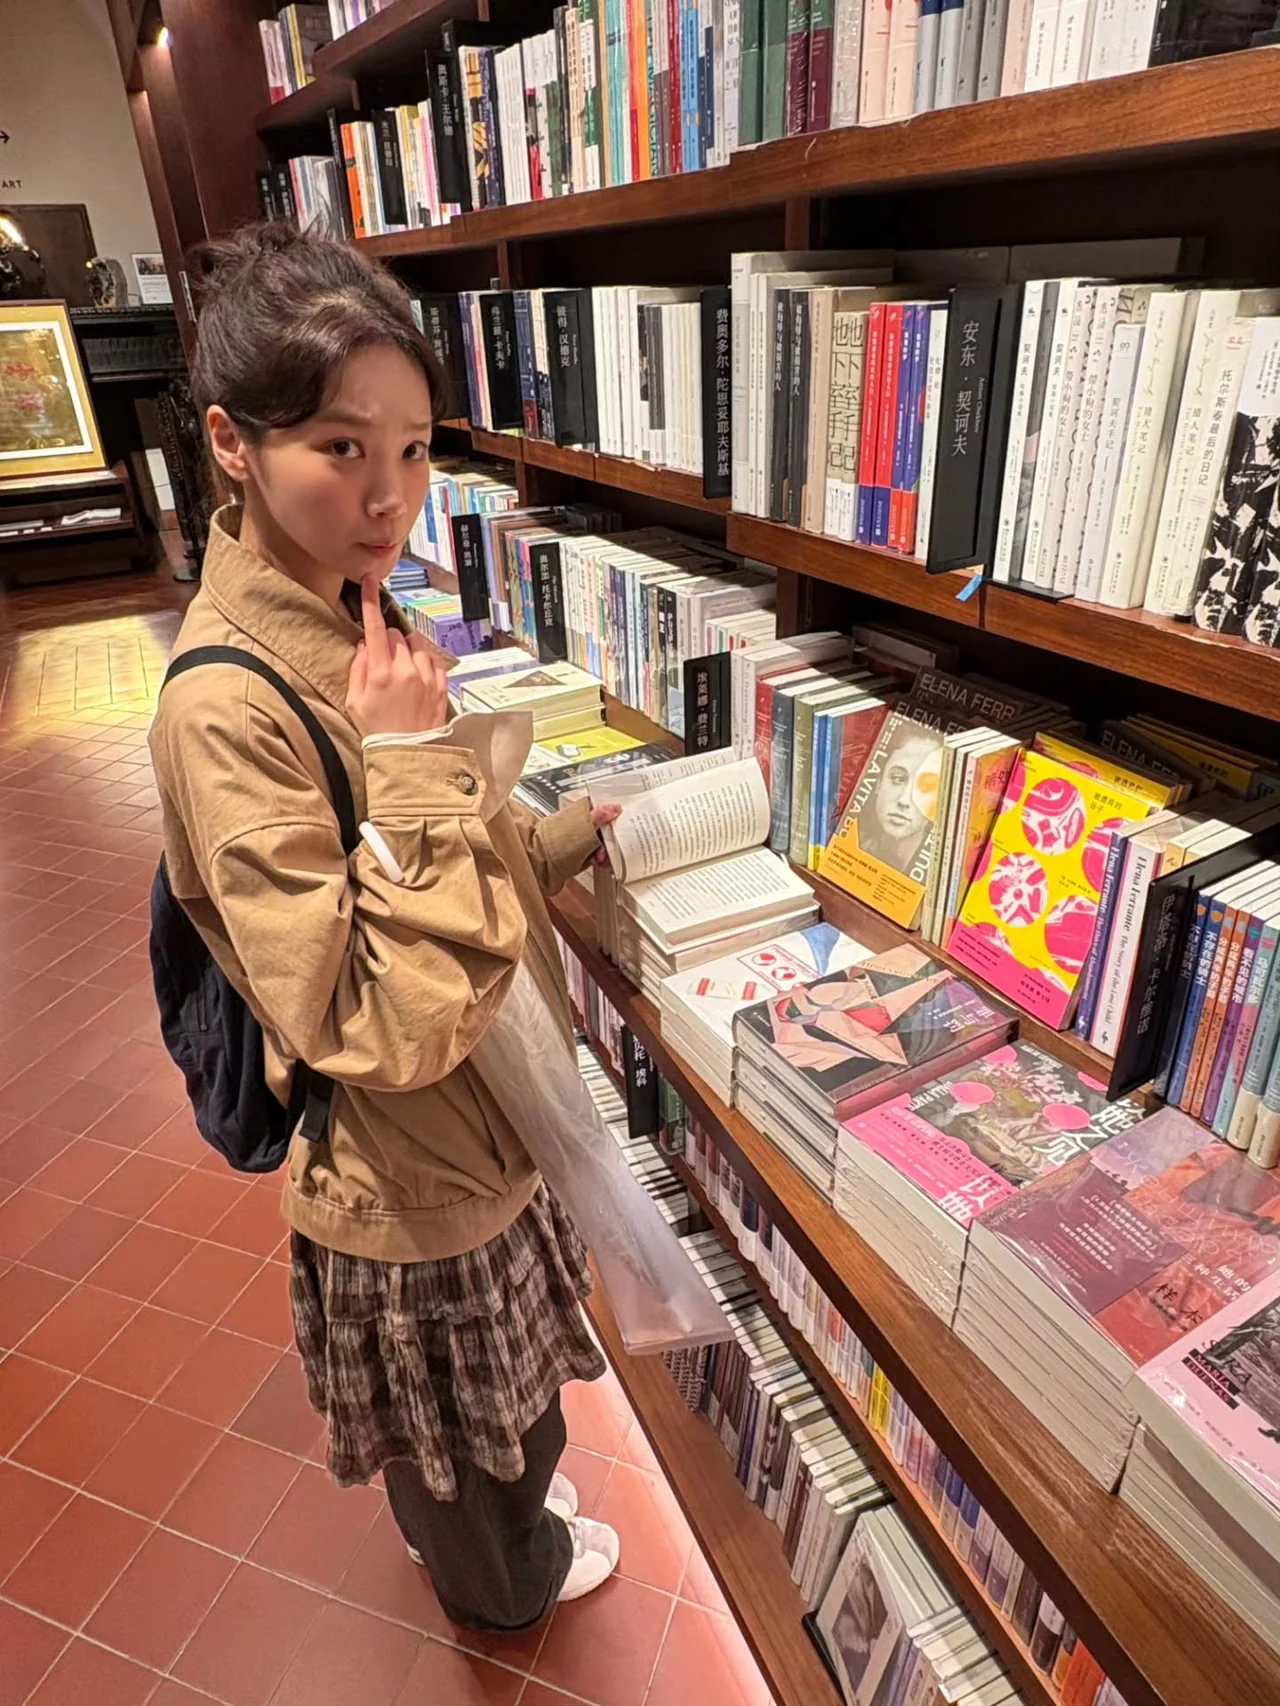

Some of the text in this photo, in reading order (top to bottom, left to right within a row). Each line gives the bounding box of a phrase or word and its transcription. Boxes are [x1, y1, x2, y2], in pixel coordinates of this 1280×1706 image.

[2, 180, 22, 189] ART
[715, 308, 730, 477] 费奥多尔·陀思妥耶夫斯基
[951, 319, 980, 458] 安东·契诃夫
[1080, 374, 1098, 442] 带小狗的女士
[1185, 407, 1202, 455] 猎人笔记
[1198, 369, 1233, 486] 托尔斯泰最后的日记
[896, 702, 942, 731] ELENA
[920, 673, 1016, 721] ELENA FERR
[868, 750, 888, 775] LA
[1101, 730, 1147, 765] ELENA
[849, 773, 878, 814] VITA
[1090, 802, 1105, 813] 日子
[1094, 792, 1122, 811] 被遗弃的
[1107, 846, 1121, 875] Elena
[1134, 855, 1147, 887] Elena
[1100, 875, 1115, 914] Ferrante
[1123, 886, 1142, 932] Ferrante
[1117, 947, 1127, 968] Story
[1121, 933, 1129, 947] The
[632, 1036, 648, 1088] 贝托·埃科
[1032, 1098, 1147, 1166] 以她之见
[1180, 1252, 1242, 1302] 三种生活
[1215, 1263, 1252, 1293] 她的
[1155, 1282, 1203, 1325] 样本
[1201, 1338, 1253, 1385] SRA
